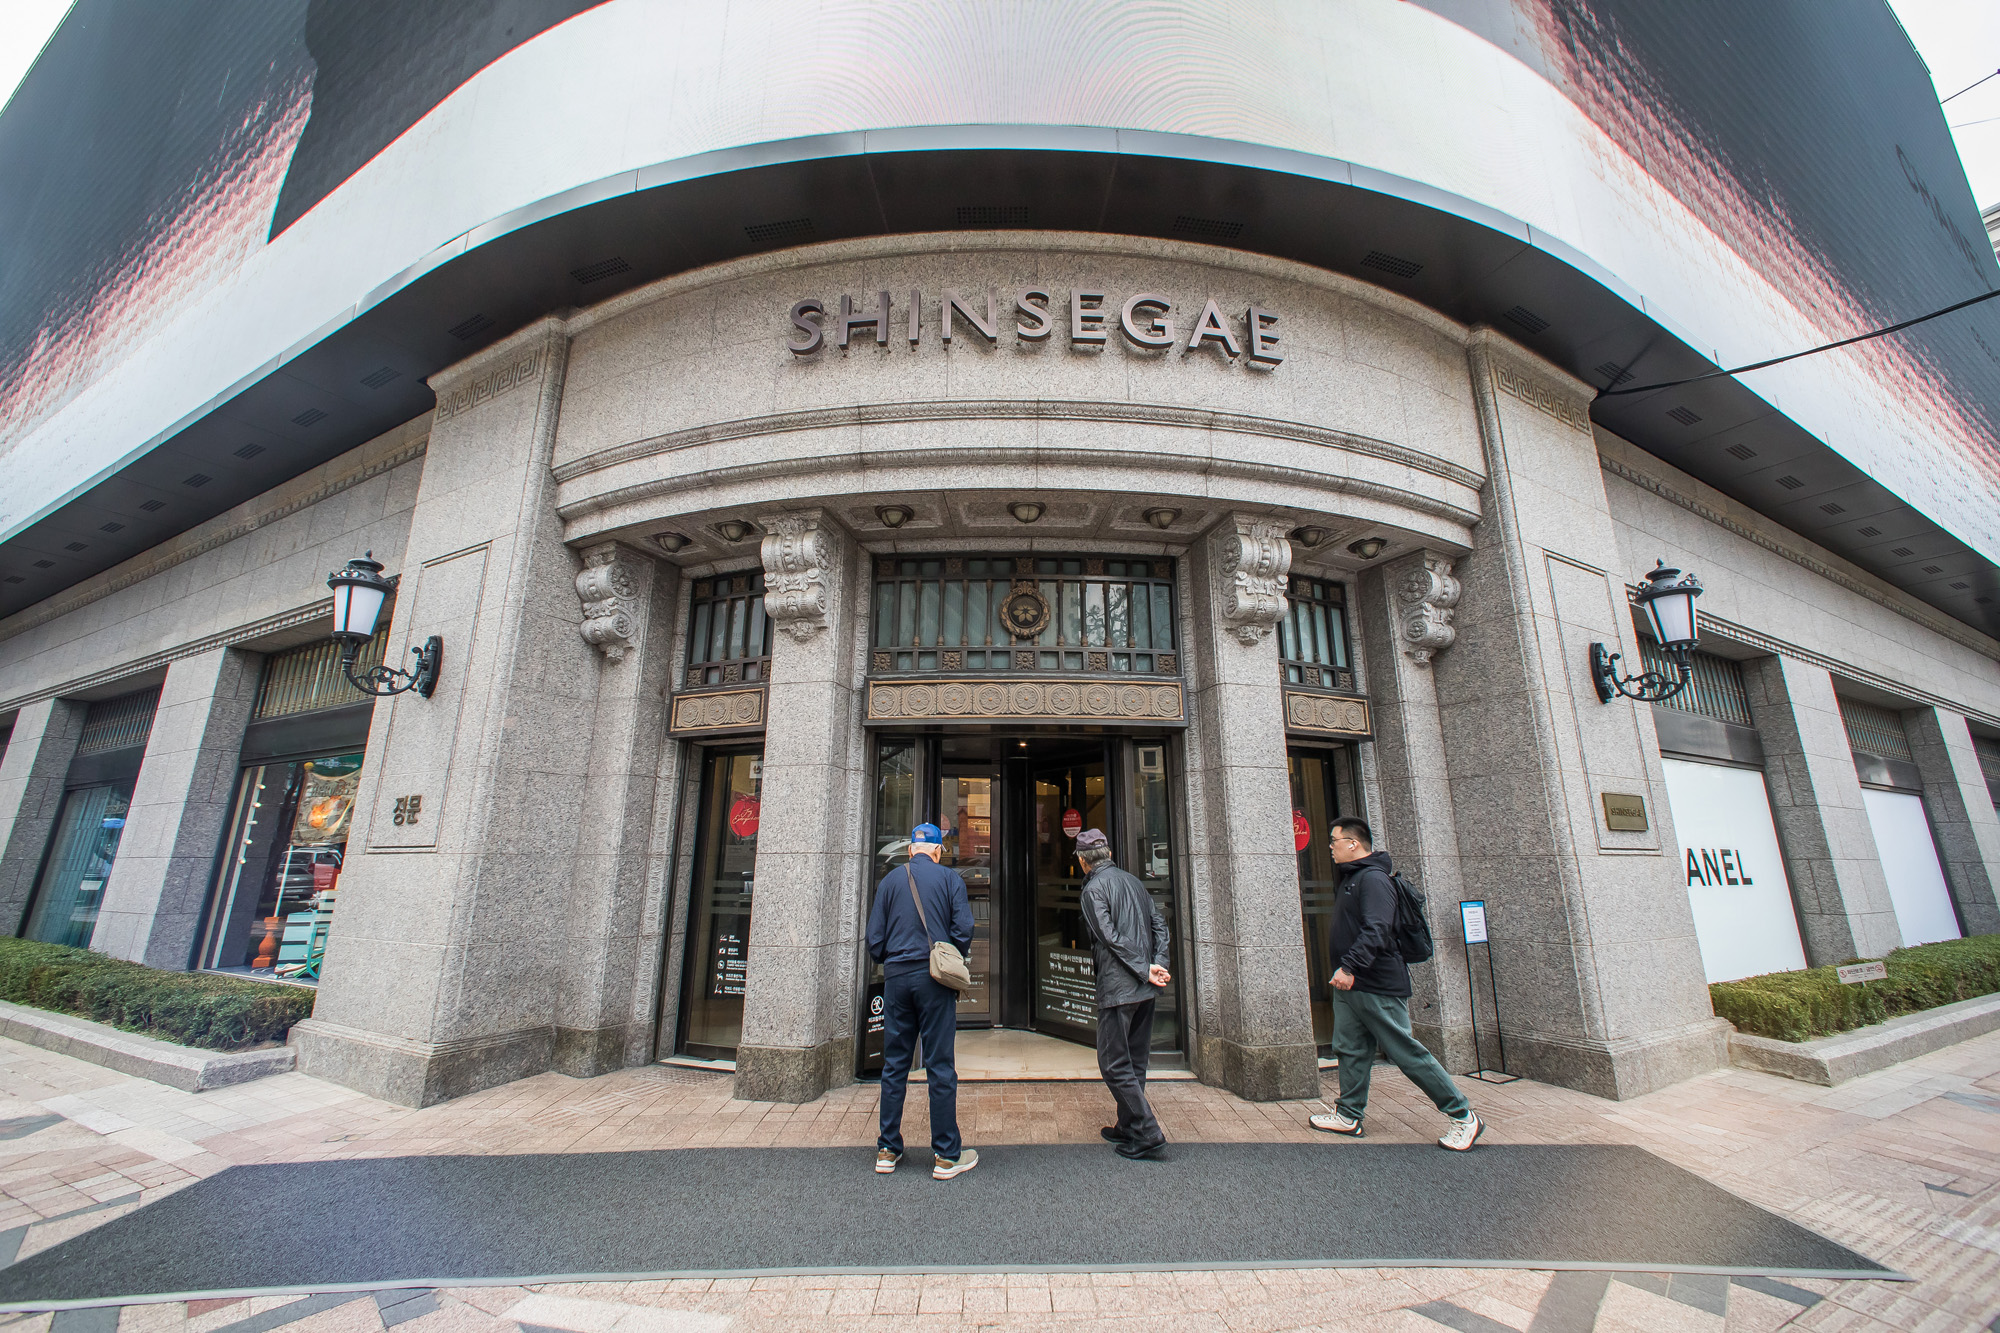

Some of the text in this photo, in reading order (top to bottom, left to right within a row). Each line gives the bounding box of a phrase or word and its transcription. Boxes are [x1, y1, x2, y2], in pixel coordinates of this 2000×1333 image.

[787, 285, 1284, 366] SHINSEGAE
[393, 795, 422, 826] 정문
[1611, 807, 1643, 818] SHINSEGAE
[1686, 848, 1753, 886] ANEL
